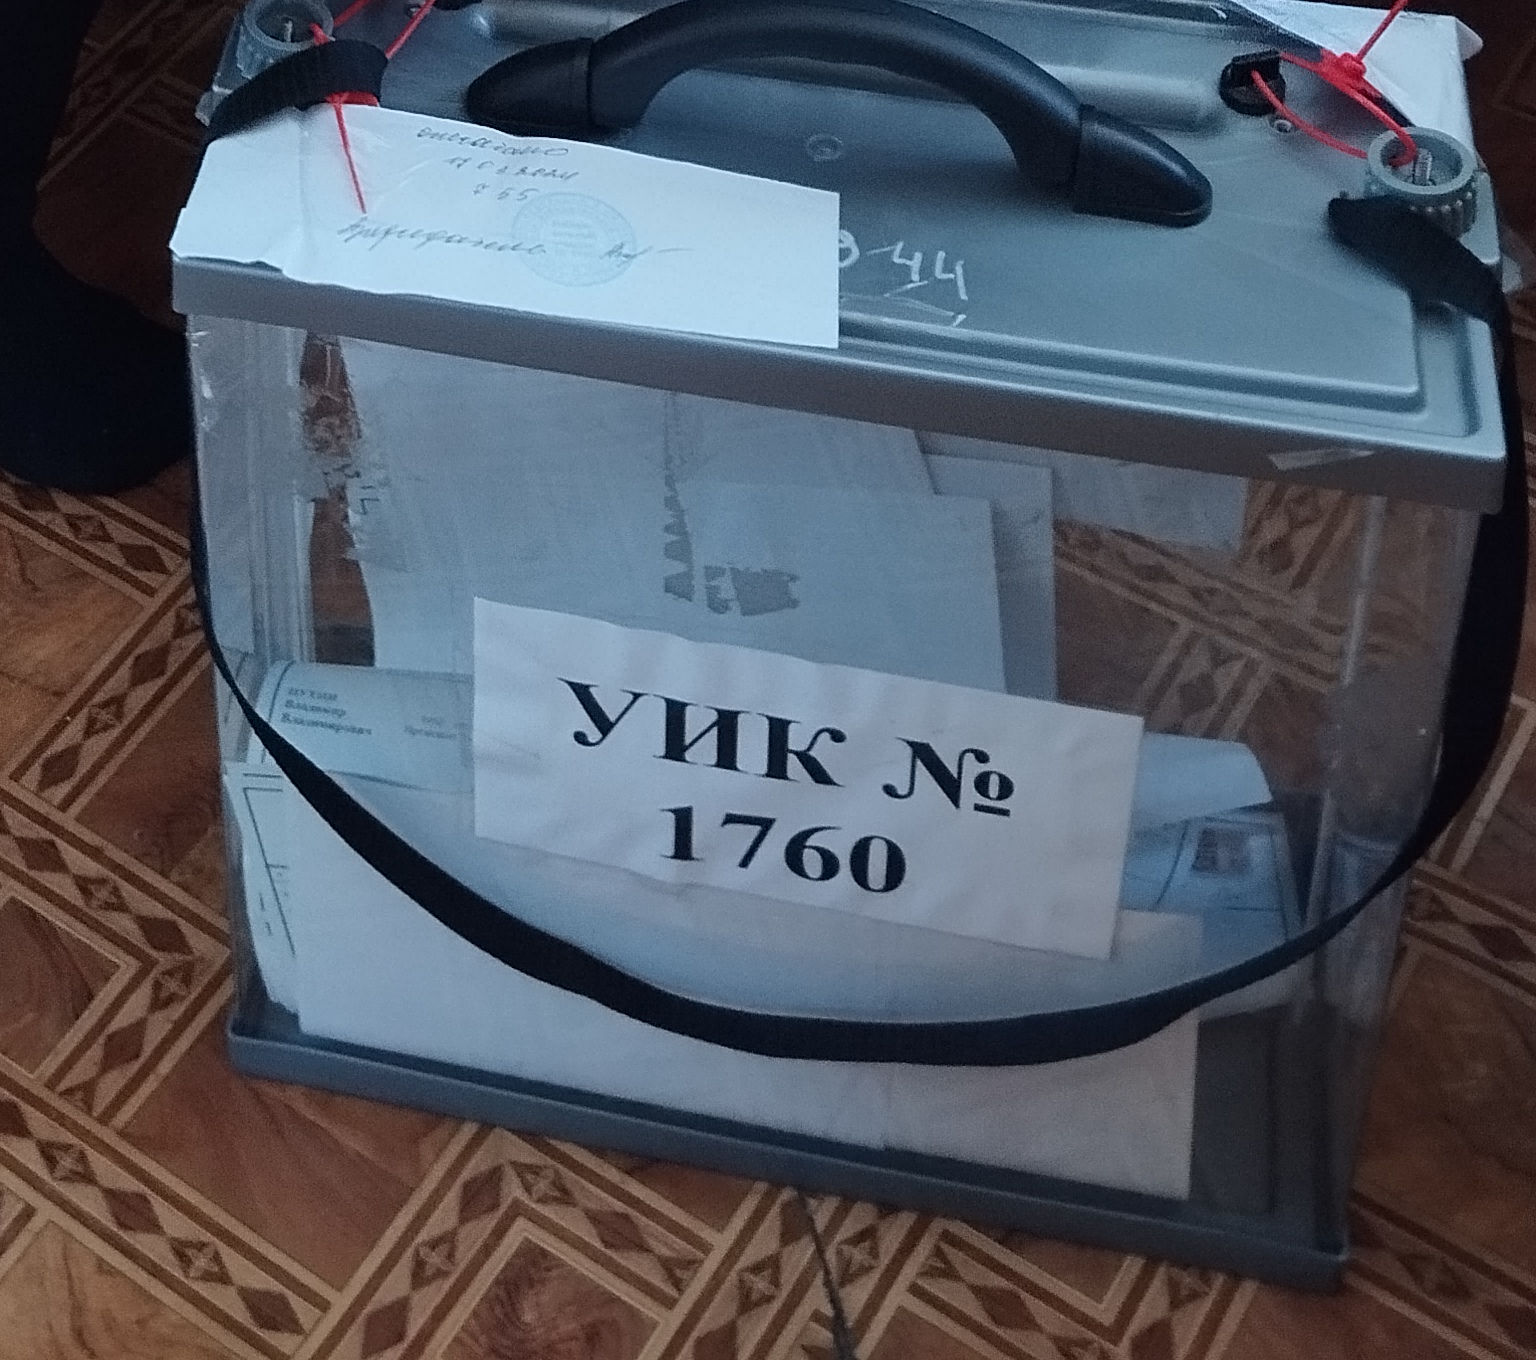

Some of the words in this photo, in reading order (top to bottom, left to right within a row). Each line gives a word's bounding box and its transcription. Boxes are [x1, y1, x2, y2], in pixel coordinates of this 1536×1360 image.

[557, 677, 847, 787] УИК
[882, 737, 1016, 818] №
[660, 805, 907, 894] 1760
